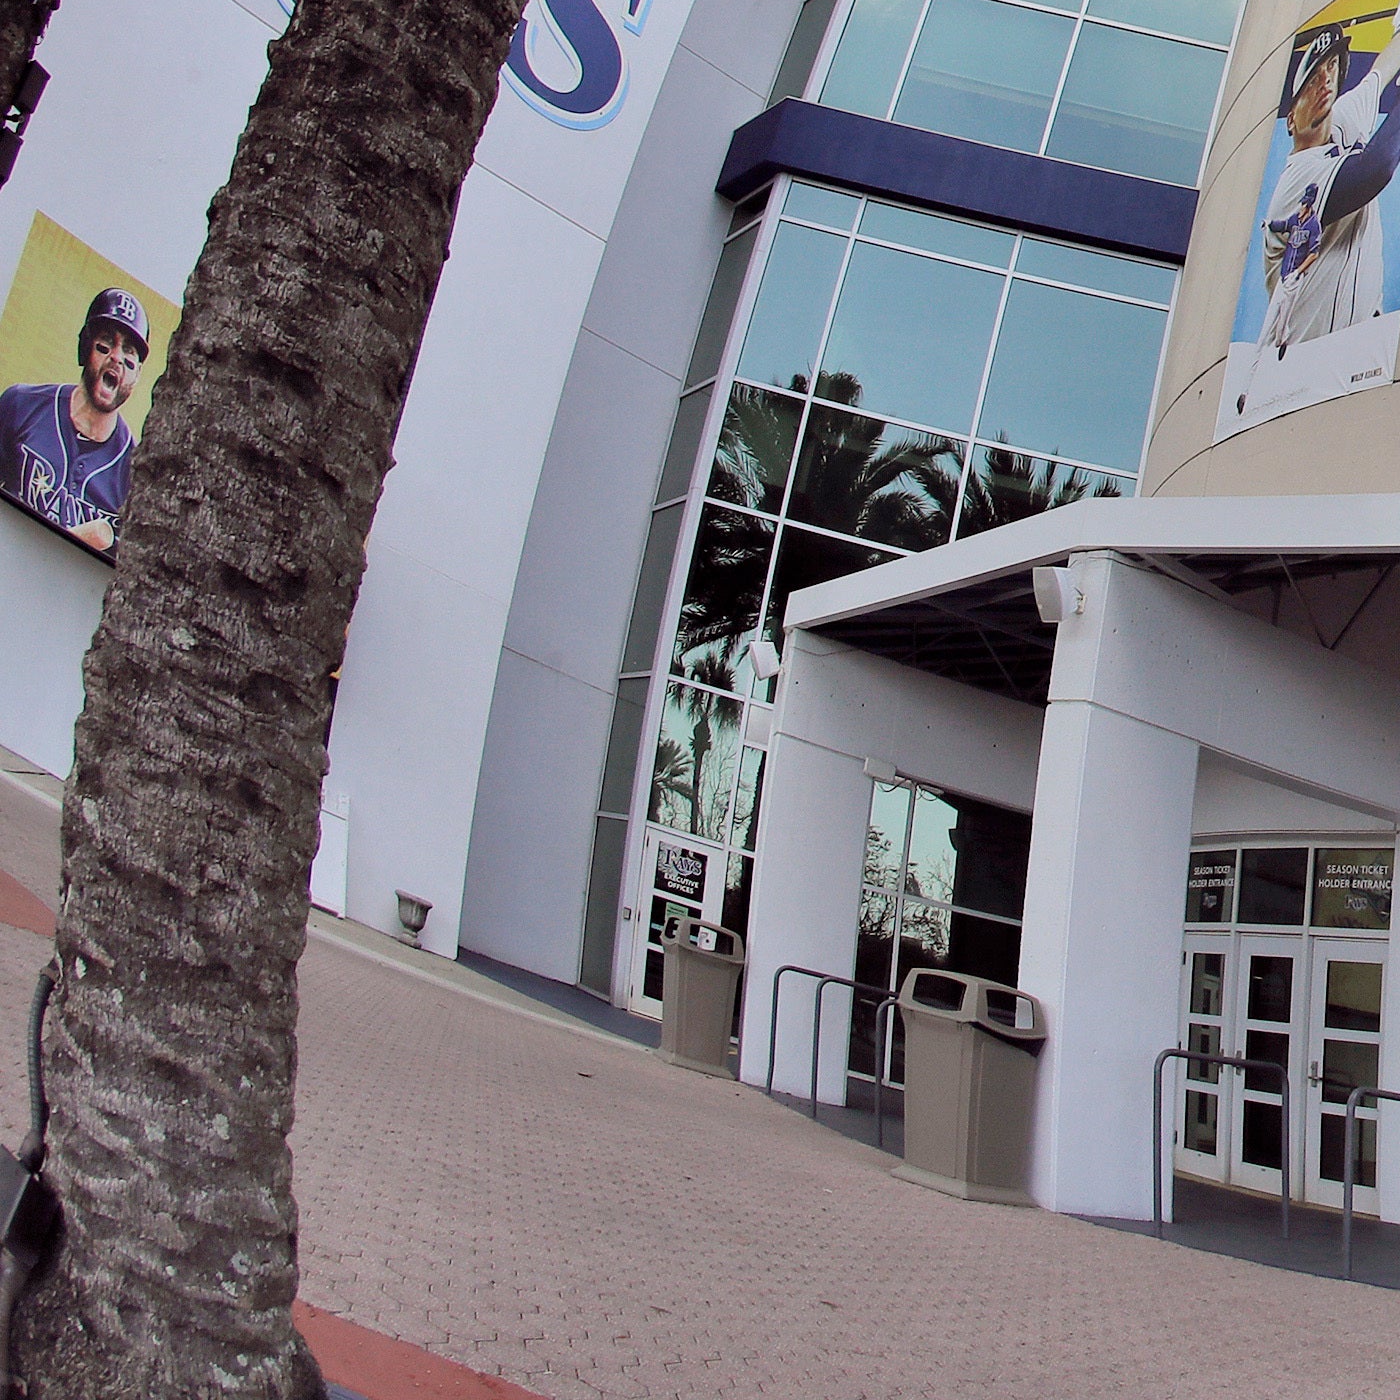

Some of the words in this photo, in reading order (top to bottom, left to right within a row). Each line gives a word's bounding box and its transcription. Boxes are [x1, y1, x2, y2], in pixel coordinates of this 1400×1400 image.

[1326, 864, 1359, 875] SEASON
[1360, 864, 1390, 875] TICKET
[1318, 878, 1351, 889] HOLDER
[1352, 879, 1392, 890] ENTRANC
